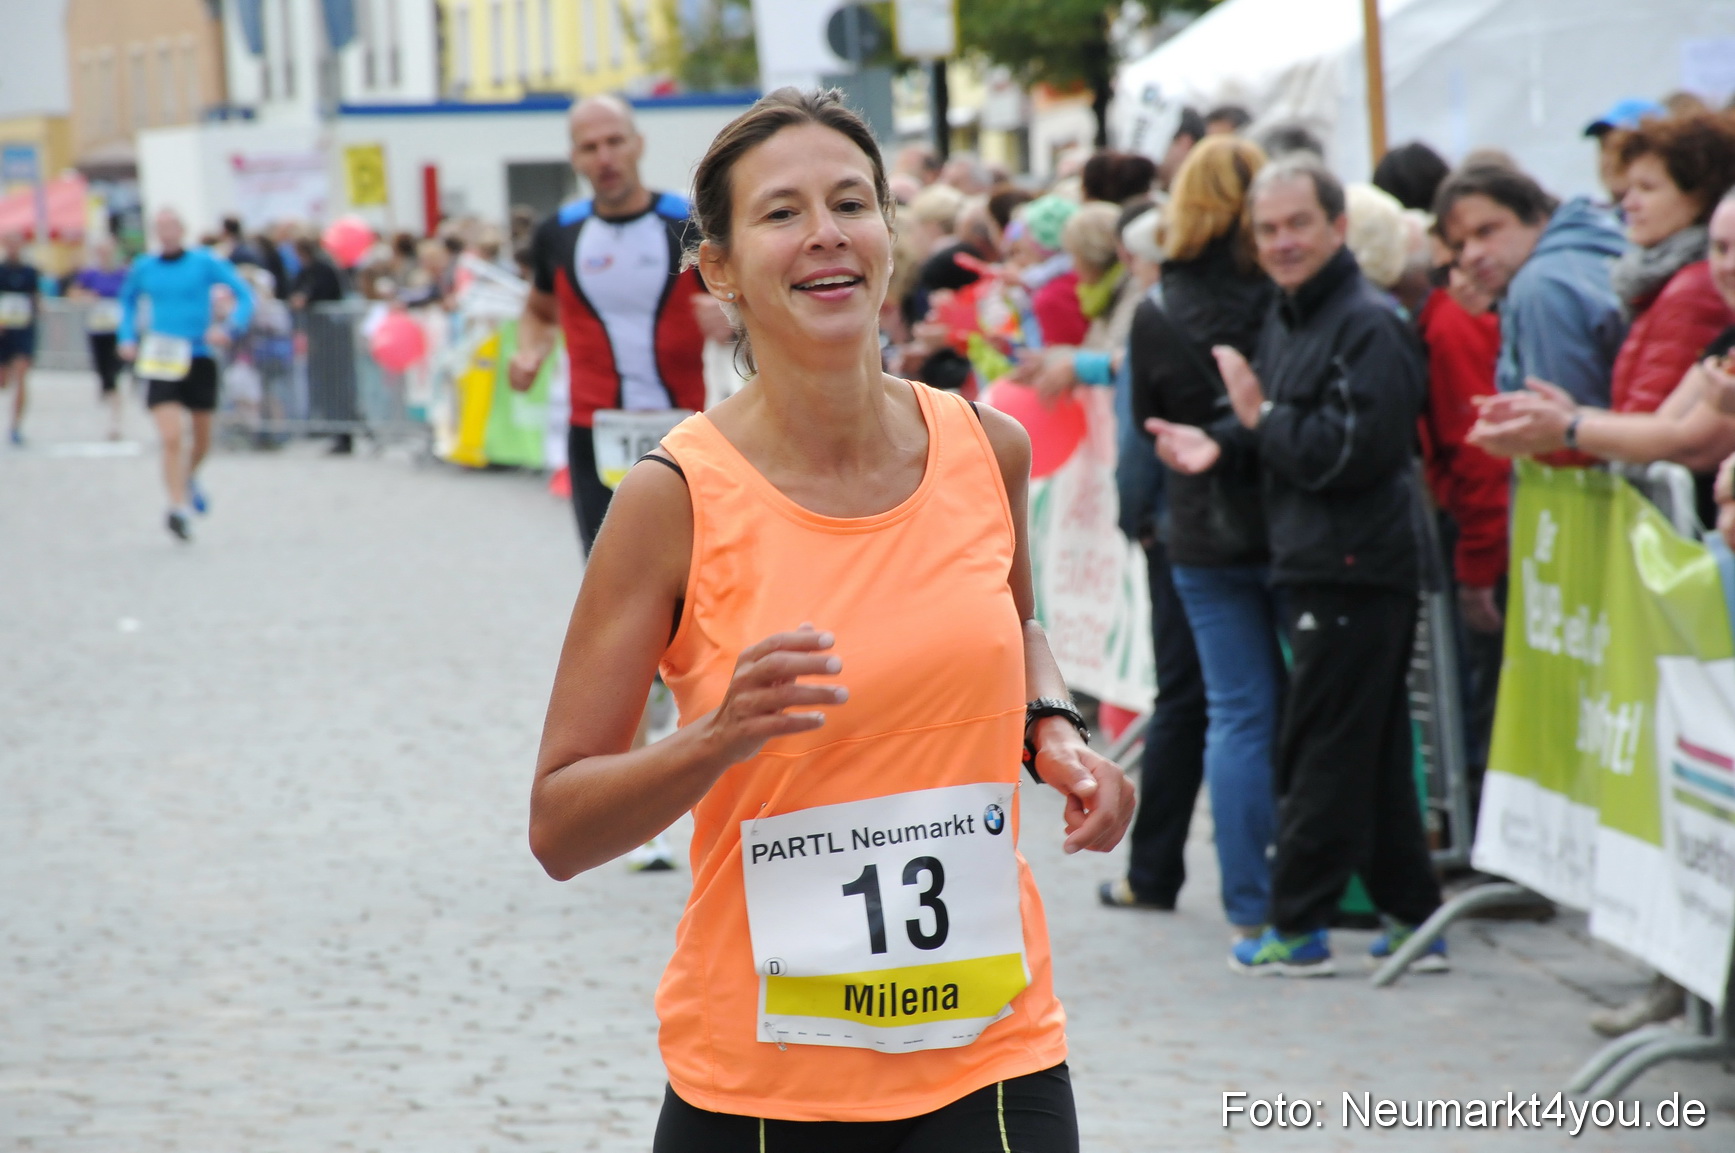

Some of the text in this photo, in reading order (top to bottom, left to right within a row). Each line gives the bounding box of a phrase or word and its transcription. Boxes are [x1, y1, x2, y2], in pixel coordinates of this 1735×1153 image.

[751, 832, 844, 864] PARTL
[851, 813, 976, 851] Neumarkt
[841, 855, 950, 956] 13
[769, 960, 781, 976] D
[844, 982, 959, 1018] Milena
